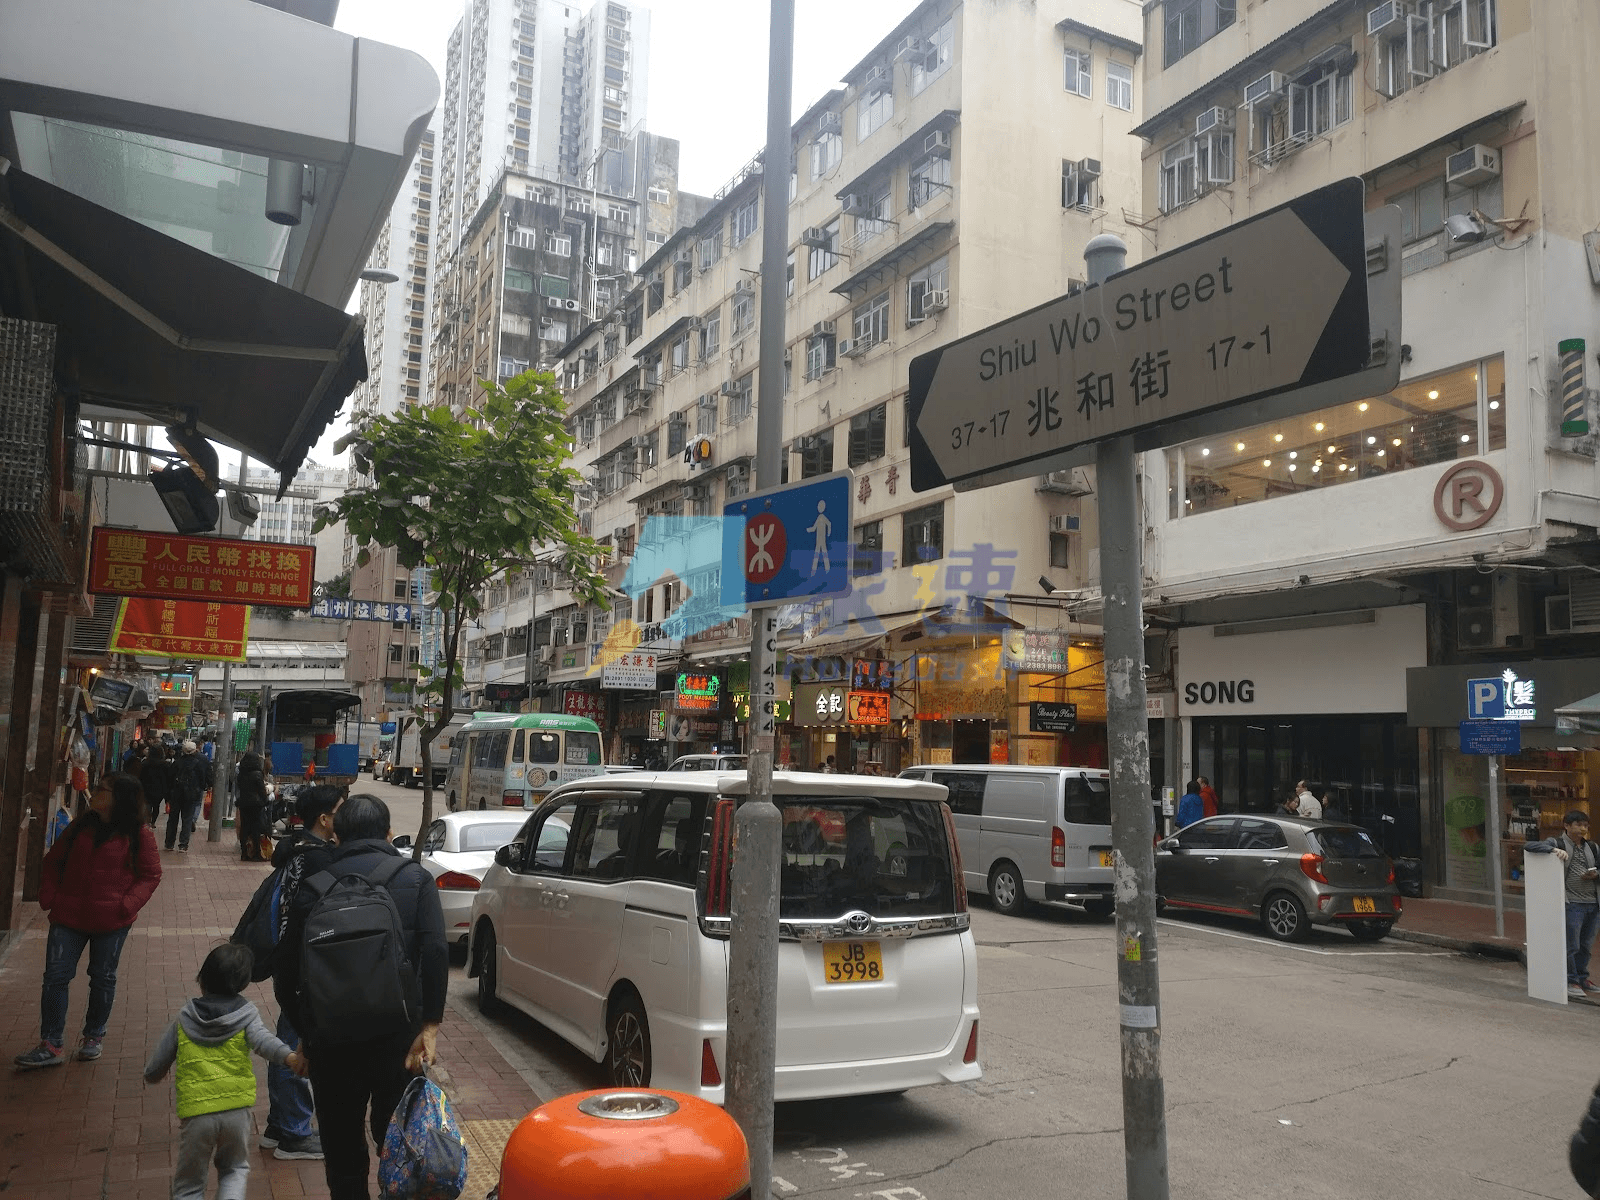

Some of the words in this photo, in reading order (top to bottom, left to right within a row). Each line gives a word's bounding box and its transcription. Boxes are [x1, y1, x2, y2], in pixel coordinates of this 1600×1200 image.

[980, 339, 1037, 381] Shiu
[1049, 312, 1101, 356] Wo
[1115, 256, 1233, 331] Street
[1028, 349, 1171, 437] 兆和街
[155, 542, 302, 571] 人民幣找換
[212, 567, 247, 578] MONEY
[249, 569, 300, 581] EXCHANGE
[1185, 680, 1255, 705] SONG
[1474, 683, 1497, 715] P
[842, 944, 865, 962] JB
[830, 961, 880, 980] 3998
